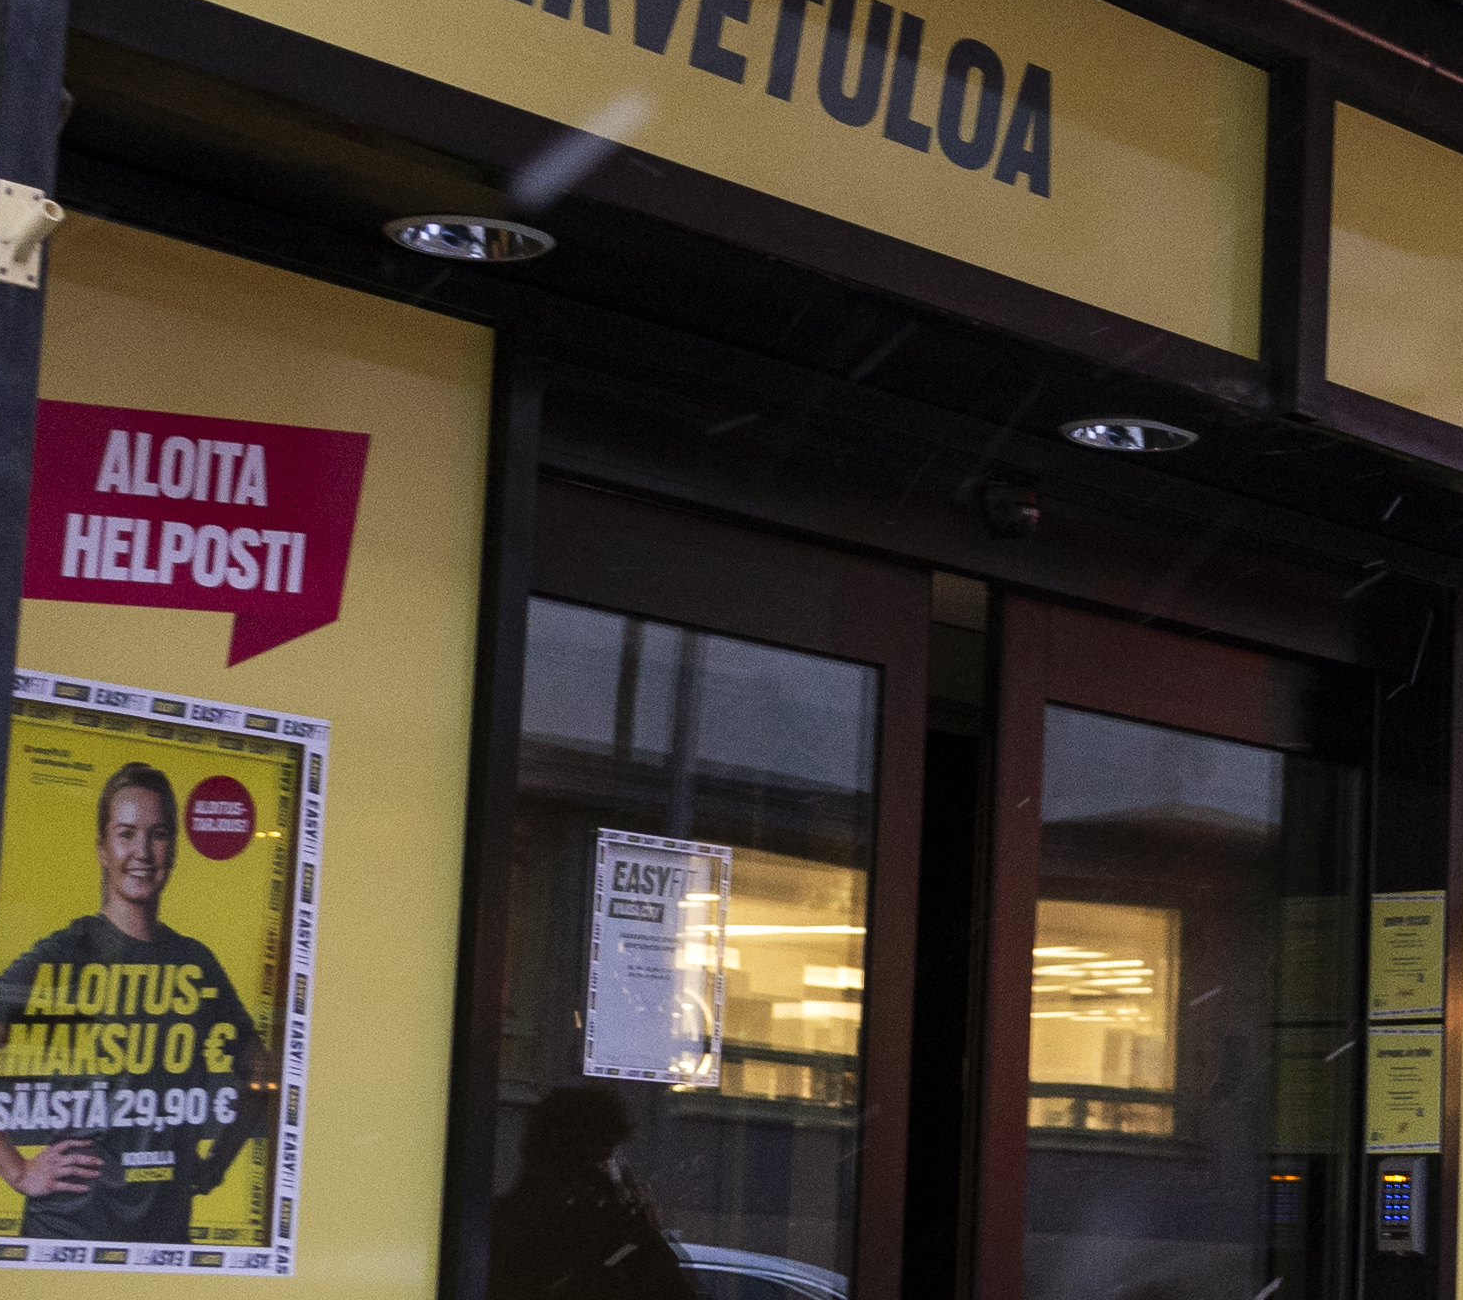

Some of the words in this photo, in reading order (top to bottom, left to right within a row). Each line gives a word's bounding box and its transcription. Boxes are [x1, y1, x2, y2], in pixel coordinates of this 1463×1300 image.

[95, 429, 268, 507] ALOITA
[60, 513, 306, 594] HELPOSTI
[24, 963, 218, 1016] ALOITUS-
[2, 1023, 159, 1076] MAKSU
[163, 1023, 196, 1074] 0
[203, 1022, 237, 1074] €
[111, 1087, 208, 1132] 29,90
[212, 1086, 238, 1124] €
